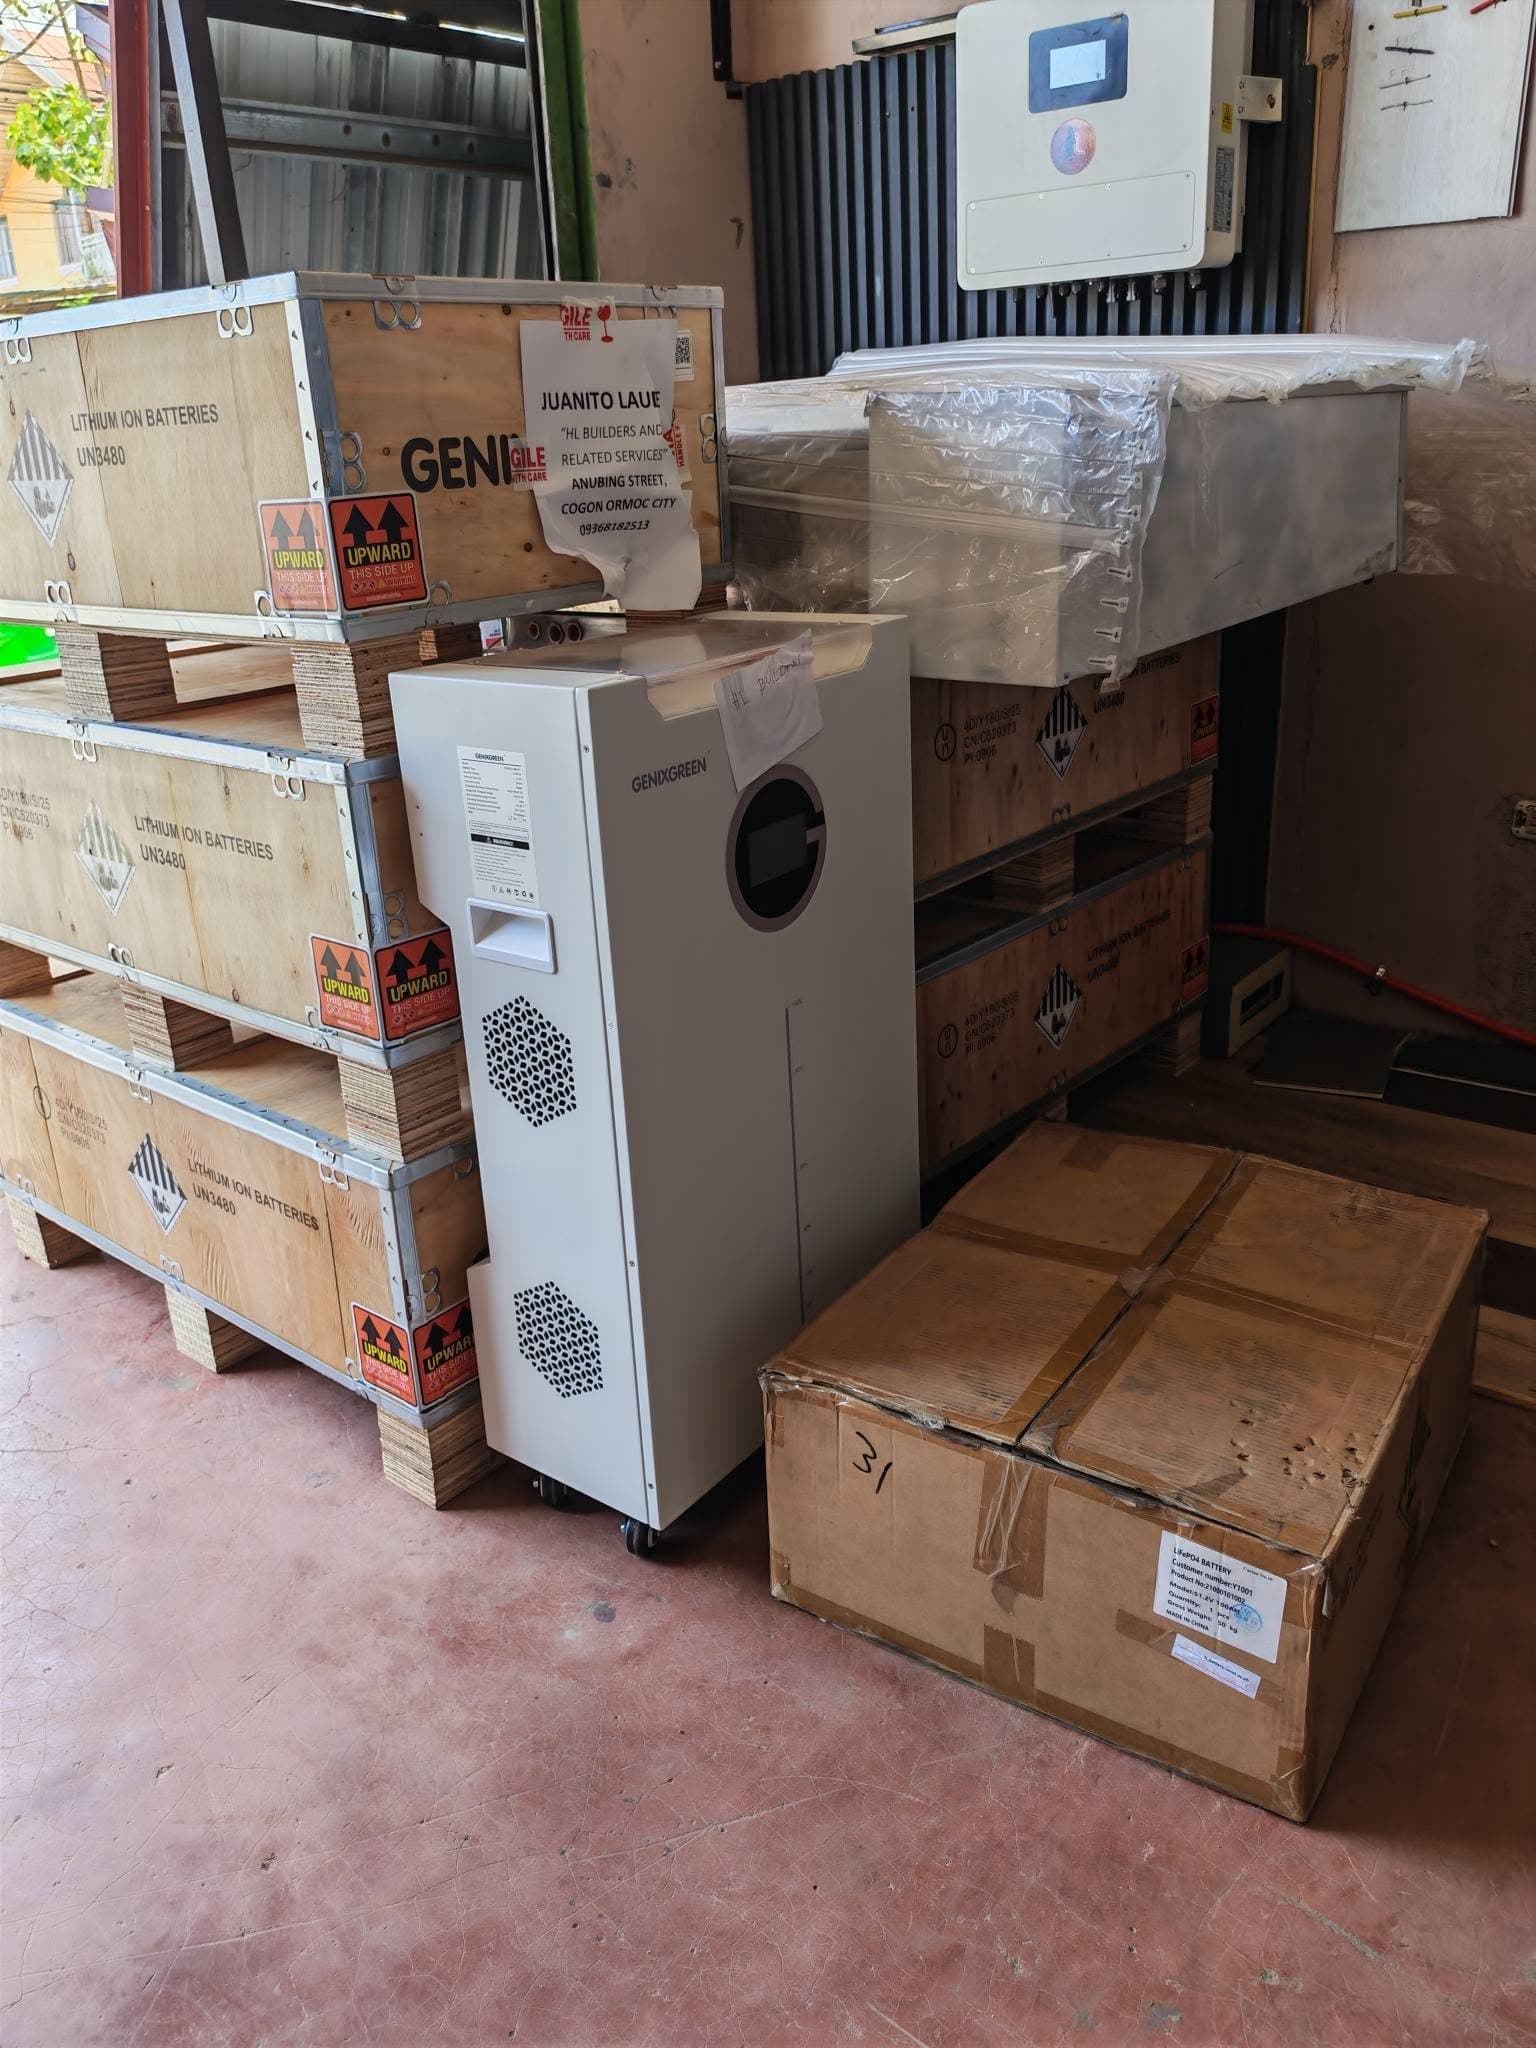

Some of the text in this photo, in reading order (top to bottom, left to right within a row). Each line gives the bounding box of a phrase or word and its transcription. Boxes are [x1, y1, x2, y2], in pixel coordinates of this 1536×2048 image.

[573, 331, 592, 341] CARE
[541, 392, 614, 411] JUANITO
[71, 404, 219, 431] LITHIUM ION BATTERIES
[583, 424, 637, 440] BUILDERS
[640, 424, 664, 437] AND
[77, 446, 126, 467] UN3480
[562, 452, 612, 466] RELATED
[528, 471, 548, 483] CARE
[572, 474, 667, 490] ANUBING STREET,
[561, 497, 676, 515] COGON ORMOC CITY
[580, 519, 650, 536] 09368182513
[274, 551, 324, 569] UPWARD
[348, 542, 412, 566] UPWARD
[276, 572, 327, 582] THIS SIDE UP
[350, 563, 414, 581] THIS SIDE UP
[631, 757, 707, 793] GENIXGREEN
[134, 816, 274, 861] LITHIUM ION BATTERIES
[140, 845, 186, 870] UN3480
[323, 977, 370, 1003] UPWARD
[390, 970, 448, 1003] UPWARD
[325, 994, 371, 1014] THIS SIDE UP
[391, 1000, 412, 1014] THIS
[414, 993, 435, 1007] SIDE
[438, 987, 450, 999] UP
[187, 1158, 319, 1231] LITHIUM ION BATTERIES
[192, 1183, 237, 1217] UN3480
[363, 1341, 407, 1373] UPWARD
[1172, 1558, 1203, 1577] Customer
[1173, 1547, 1200, 1563] LiFePO4
[1201, 1558, 1232, 1576] BATTERY
[1170, 1569, 1194, 1584] Product
[1168, 1591, 1201, 1608] Quantity:
[1217, 1612, 1230, 1620] pcs
[1166, 1609, 1209, 1632] MADE IN CHINA
[1167, 1600, 1238, 1634] Gross Weight: 50 kg
